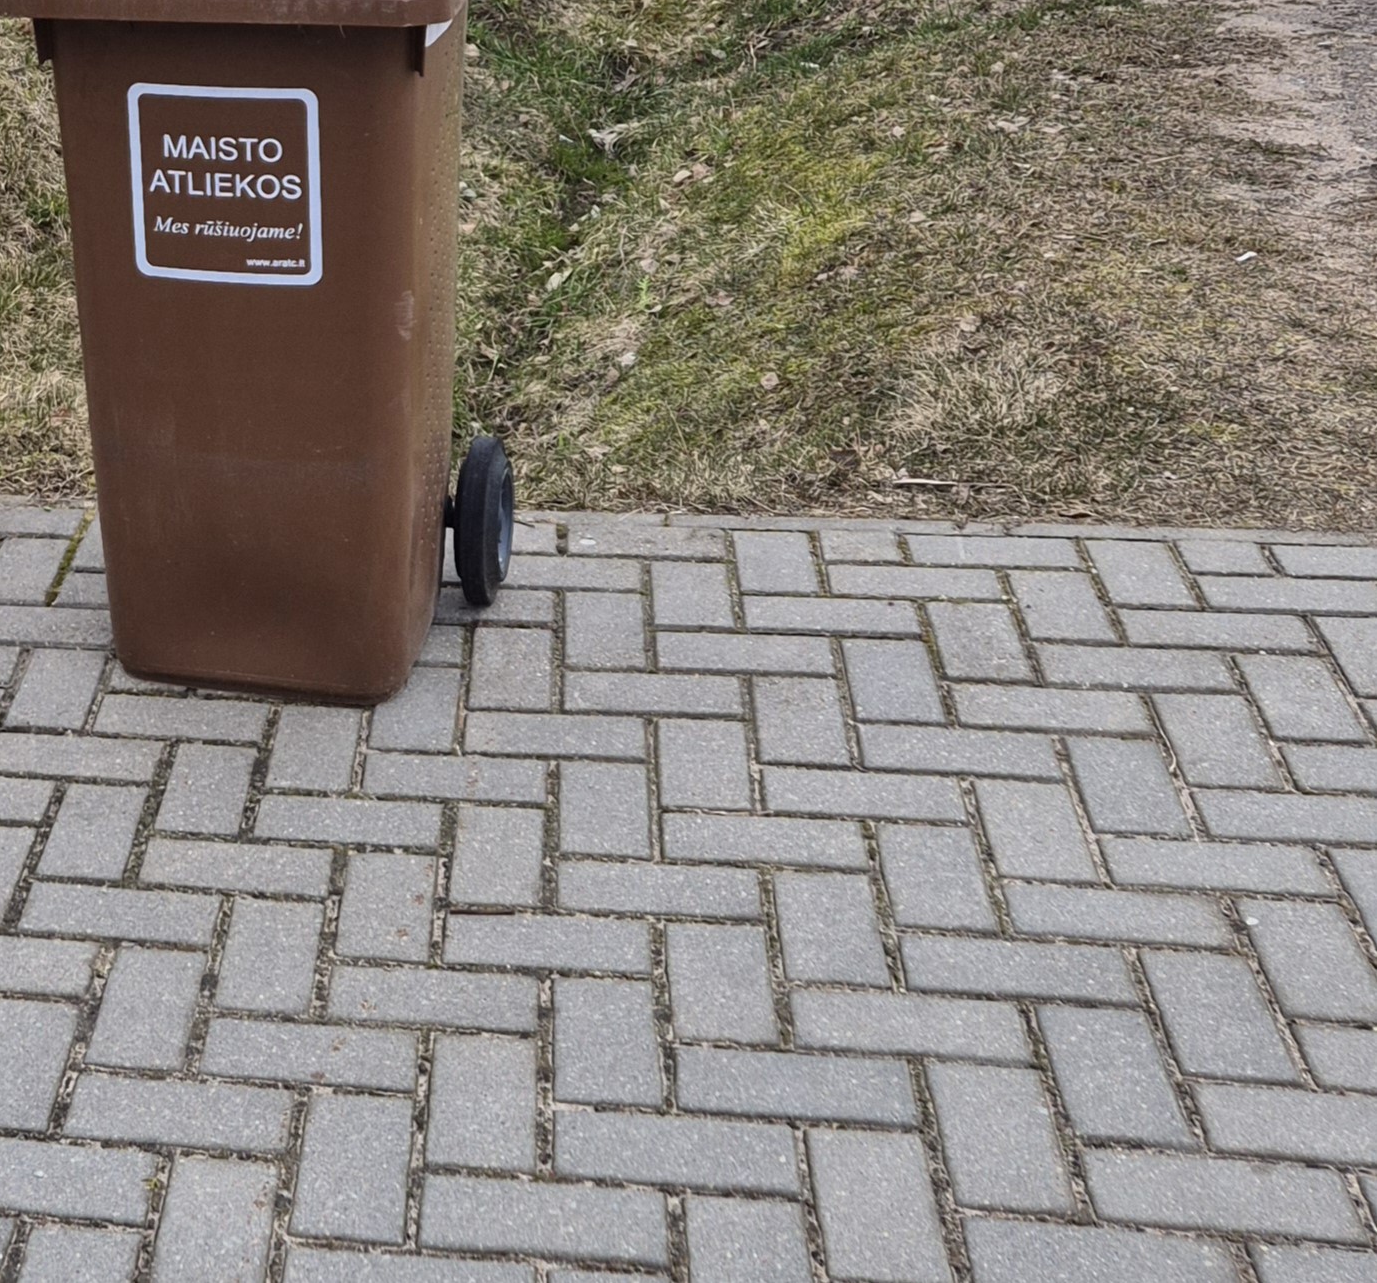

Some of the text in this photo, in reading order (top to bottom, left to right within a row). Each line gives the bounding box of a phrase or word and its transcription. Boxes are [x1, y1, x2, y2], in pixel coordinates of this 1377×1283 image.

[163, 134, 283, 163] MAISTO
[149, 169, 303, 200] ATLIEKOS
[153, 216, 303, 243] Mes rūšiuojame!
